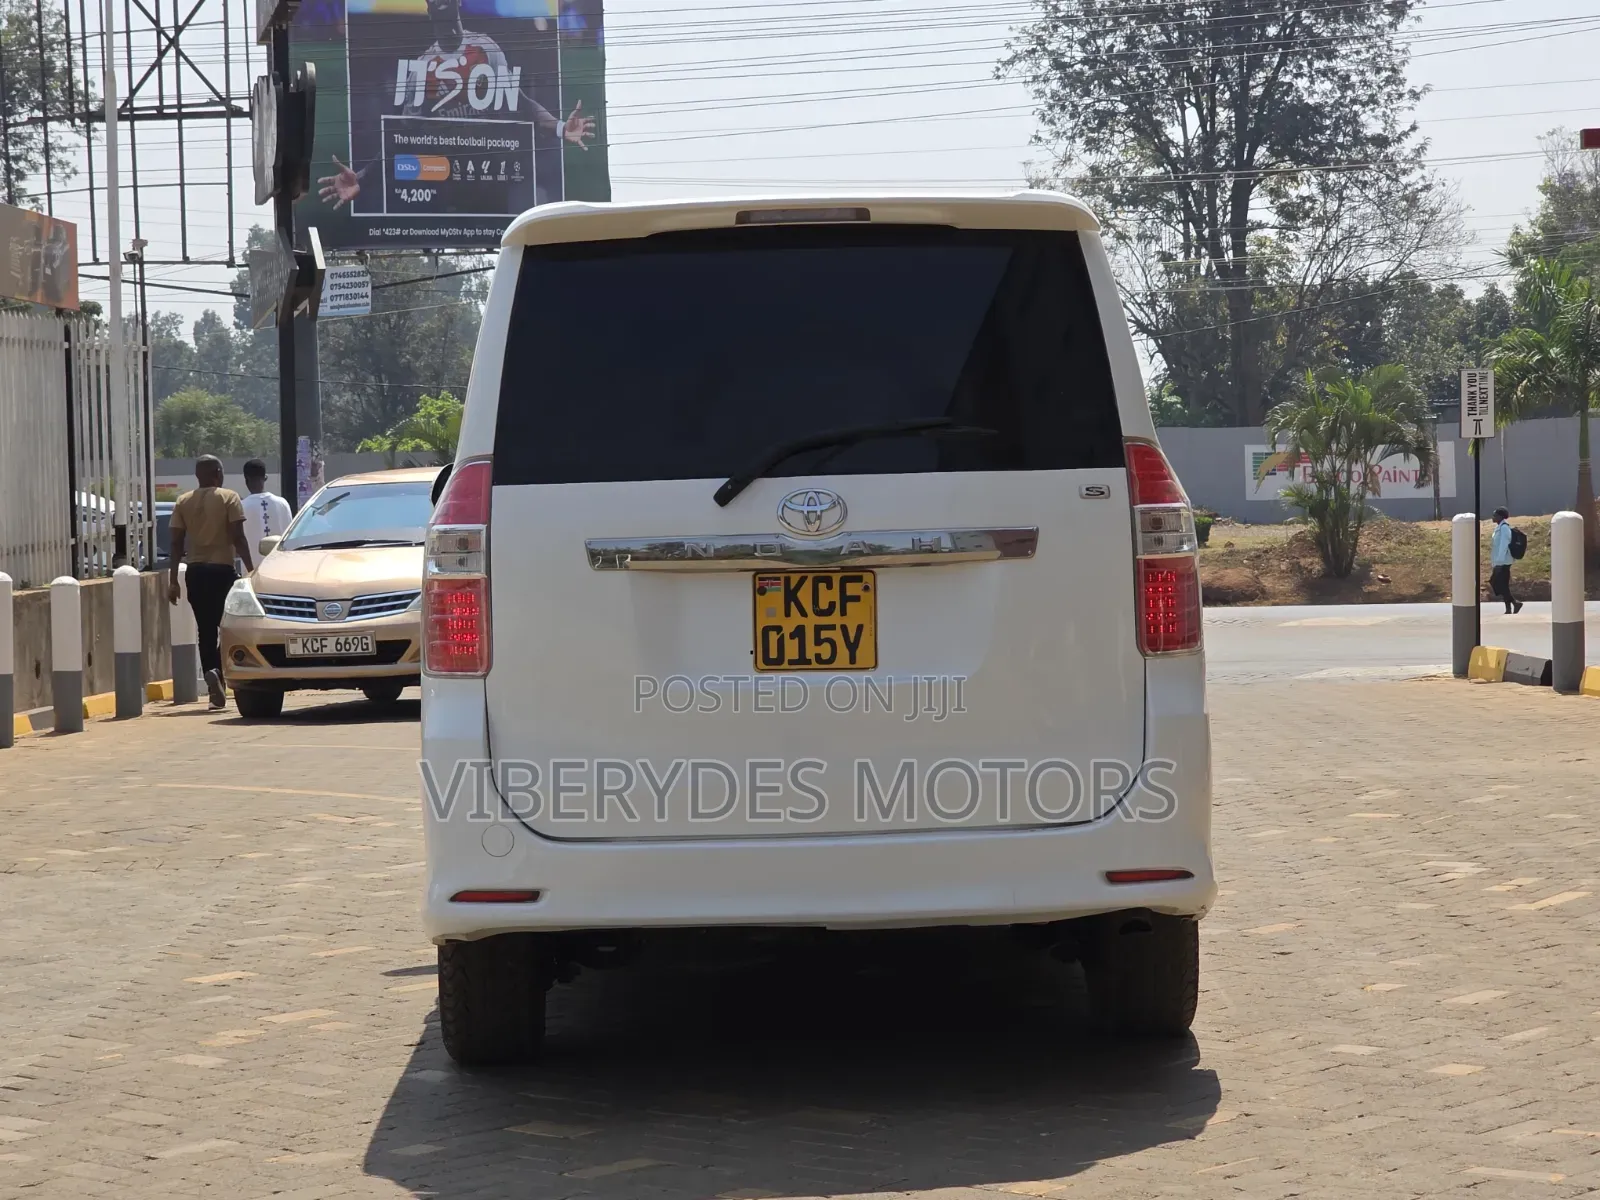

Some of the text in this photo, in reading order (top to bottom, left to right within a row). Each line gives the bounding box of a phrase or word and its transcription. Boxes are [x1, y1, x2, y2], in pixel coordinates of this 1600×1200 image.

[394, 59, 521, 112] IT'S ON
[393, 133, 520, 151] The world's best football package
[400, 188, 432, 203] 4,200
[369, 227, 382, 236] Dial
[409, 227, 440, 236] Download
[462, 227, 476, 238] App
[475, 228, 483, 236] to
[482, 227, 496, 238] stay
[329, 291, 370, 303] 0771830144
[1479, 371, 1489, 386] TIME
[1467, 372, 1478, 417] THANK YOU
[1479, 387, 1489, 405] NEXT
[1085, 486, 1106, 497] S
[783, 575, 864, 618] KCF
[302, 636, 370, 653] KCF 669G
[761, 623, 864, 666] 015Y
